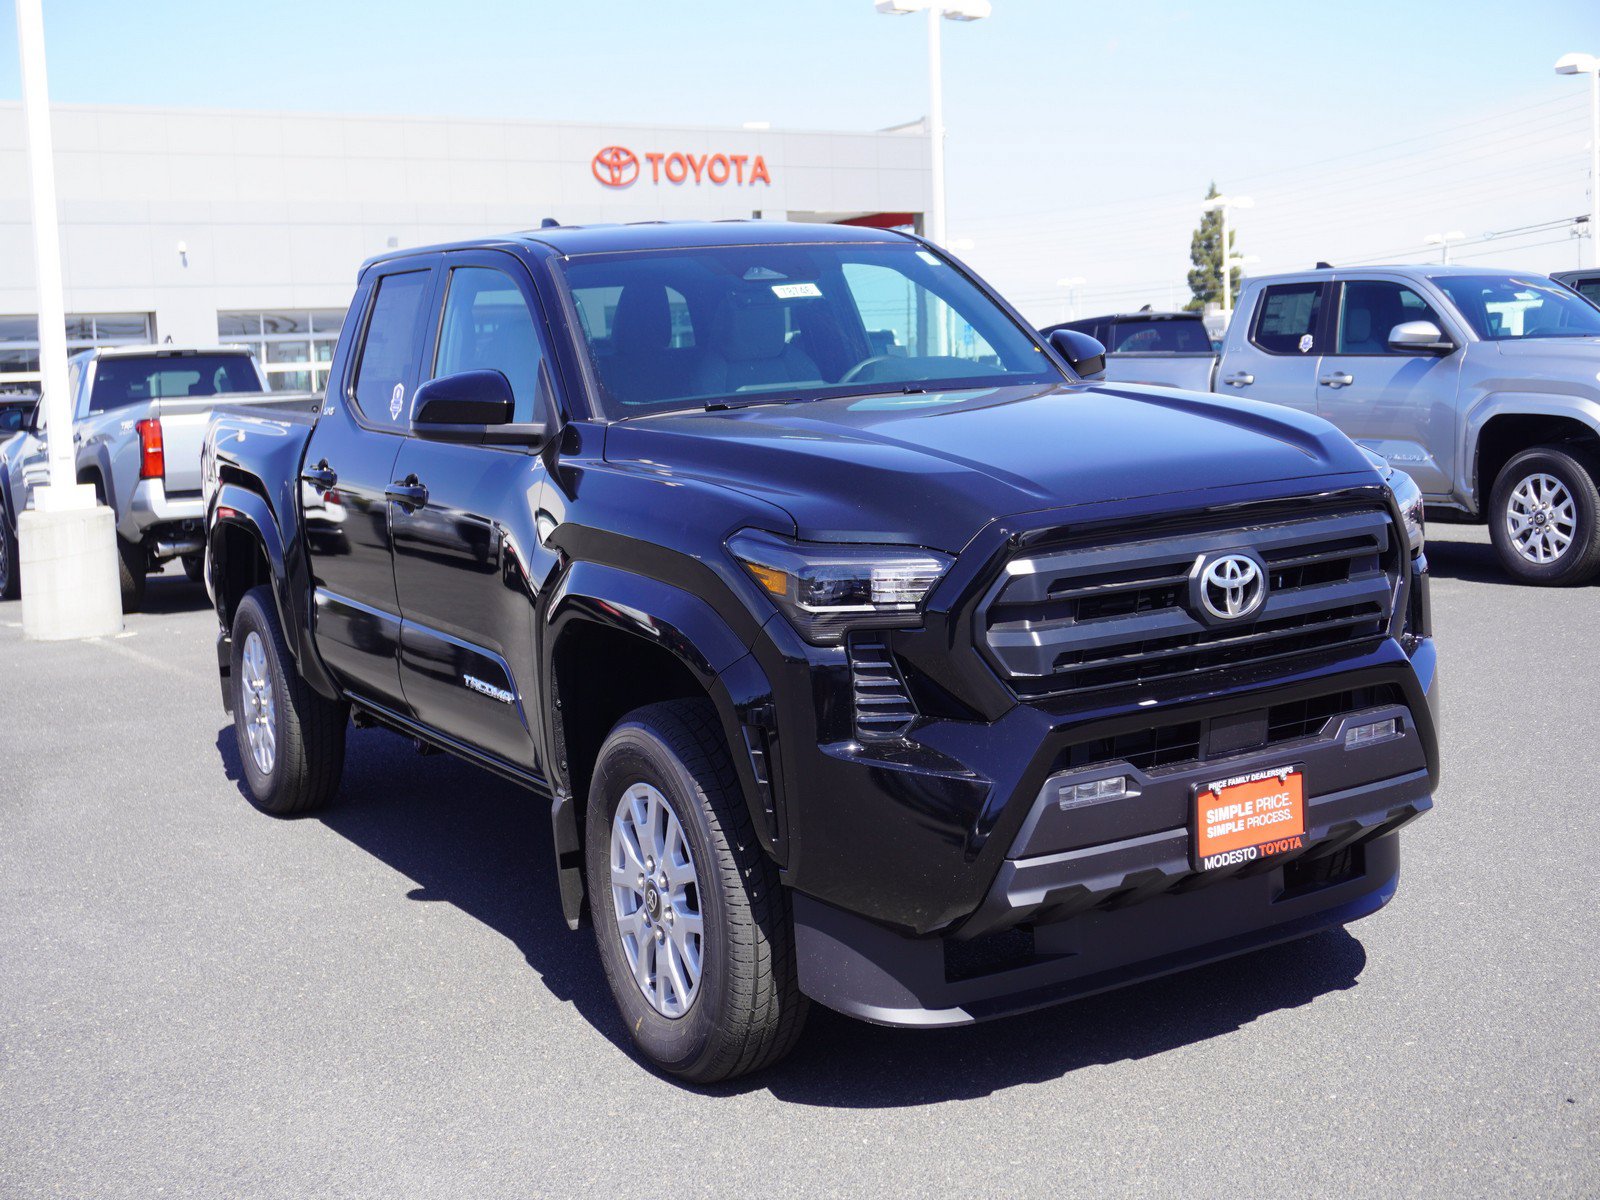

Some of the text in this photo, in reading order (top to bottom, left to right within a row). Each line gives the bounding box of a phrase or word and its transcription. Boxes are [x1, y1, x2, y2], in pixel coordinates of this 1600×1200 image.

[645, 152, 771, 185] TOYOTA
[1208, 766, 1293, 791] PRICE FAMILY DEALERSHIPS
[1206, 792, 1293, 824] SIMPLE PRICE.
[1206, 808, 1293, 839] SIMPLE PROCESS.
[1204, 836, 1303, 870] MODESTO TOYOTA
